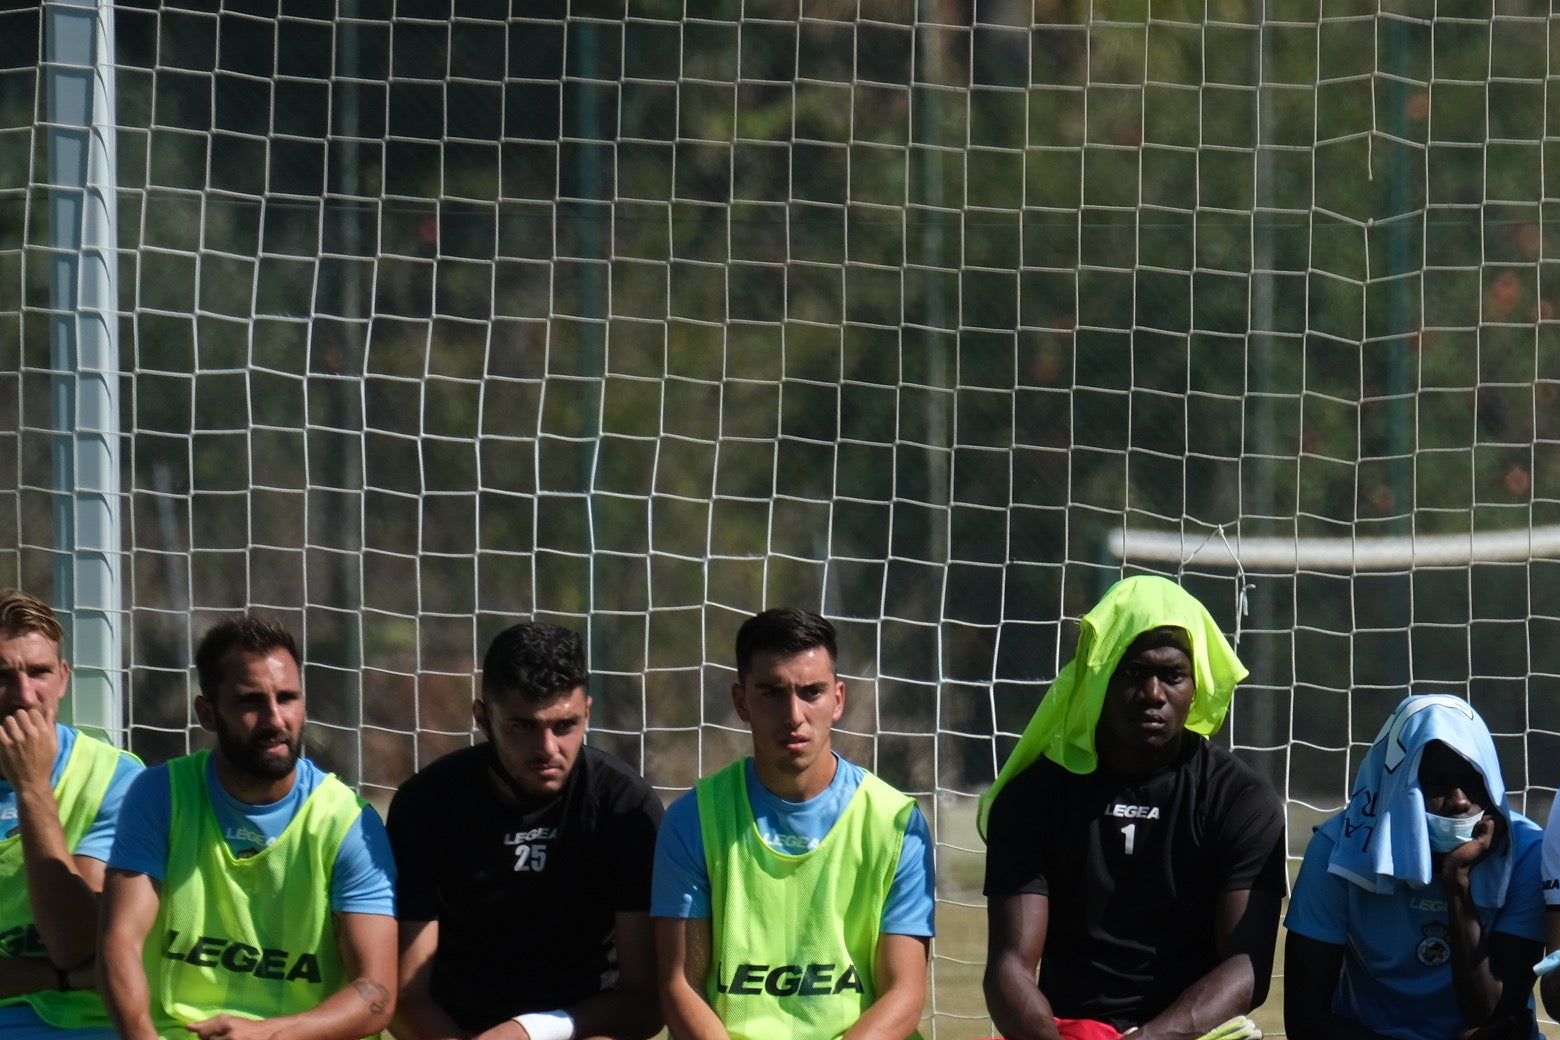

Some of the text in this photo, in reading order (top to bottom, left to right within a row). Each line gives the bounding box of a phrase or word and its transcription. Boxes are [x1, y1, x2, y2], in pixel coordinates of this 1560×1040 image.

[1104, 803, 1160, 820] LEGEA
[1120, 823, 1136, 855] 1
[513, 844, 548, 873] 25
[161, 929, 322, 984] LEGEA
[716, 960, 865, 997] LEGEA
